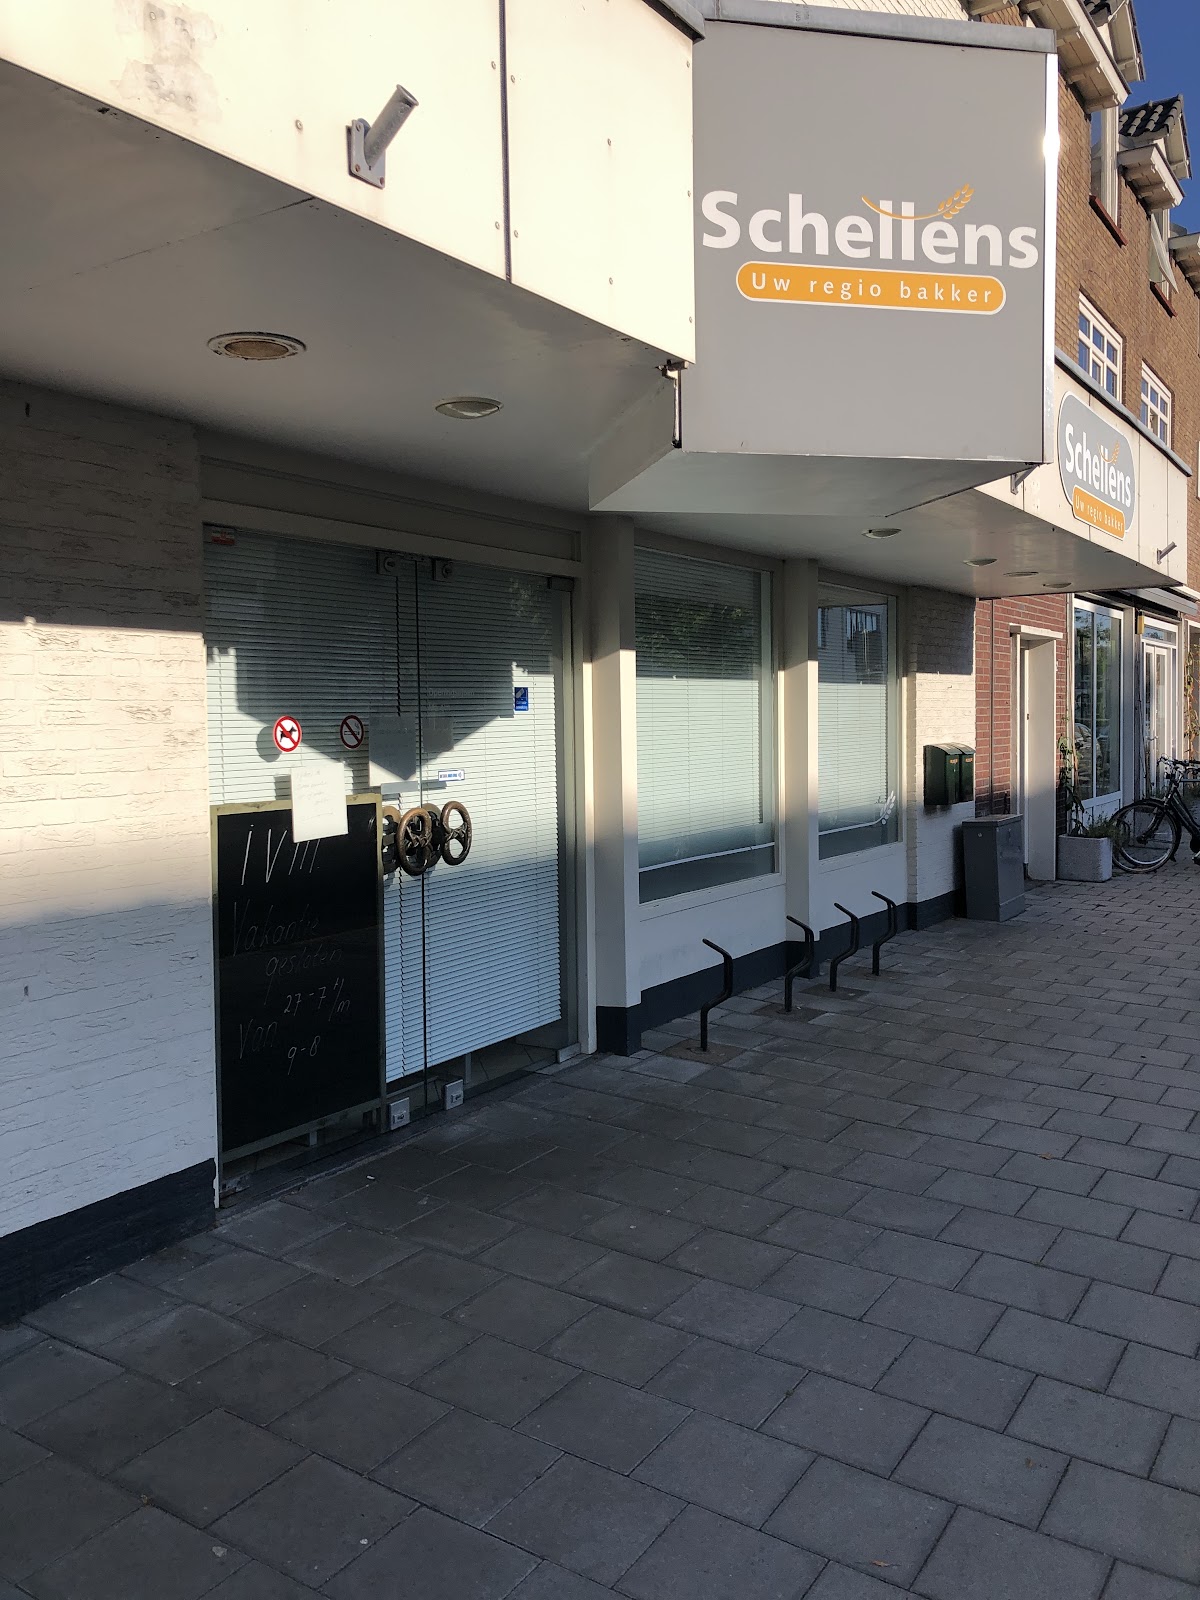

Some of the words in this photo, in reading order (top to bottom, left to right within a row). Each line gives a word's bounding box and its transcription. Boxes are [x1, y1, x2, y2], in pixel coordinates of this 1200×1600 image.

[701, 190, 1039, 269] Schellens
[752, 272, 791, 291] Uw
[809, 278, 882, 301] regio
[900, 281, 992, 304] bakker
[1065, 423, 1131, 507] Schellens
[1087, 504, 1102, 523] regio
[1104, 513, 1124, 532] bakker
